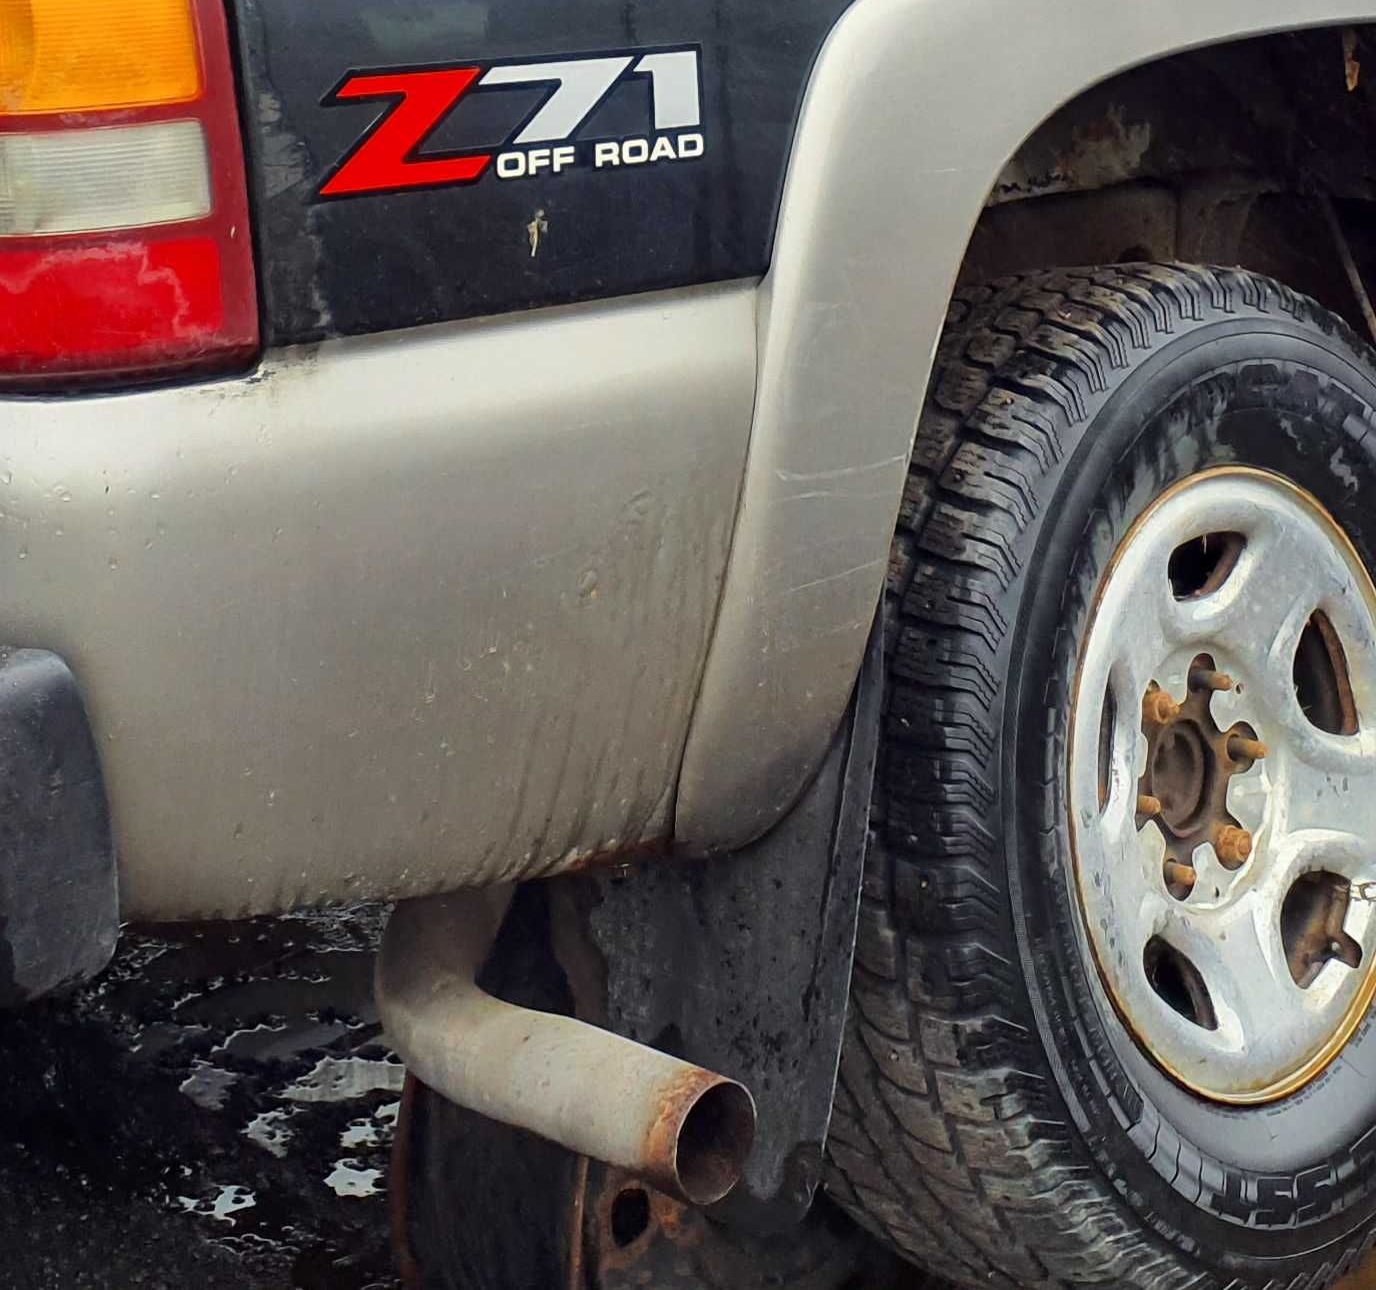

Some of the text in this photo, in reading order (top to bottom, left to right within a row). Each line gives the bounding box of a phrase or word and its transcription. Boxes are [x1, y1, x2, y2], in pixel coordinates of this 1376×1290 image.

[318, 49, 701, 197] Z71
[496, 132, 705, 180] OFF ROAD
